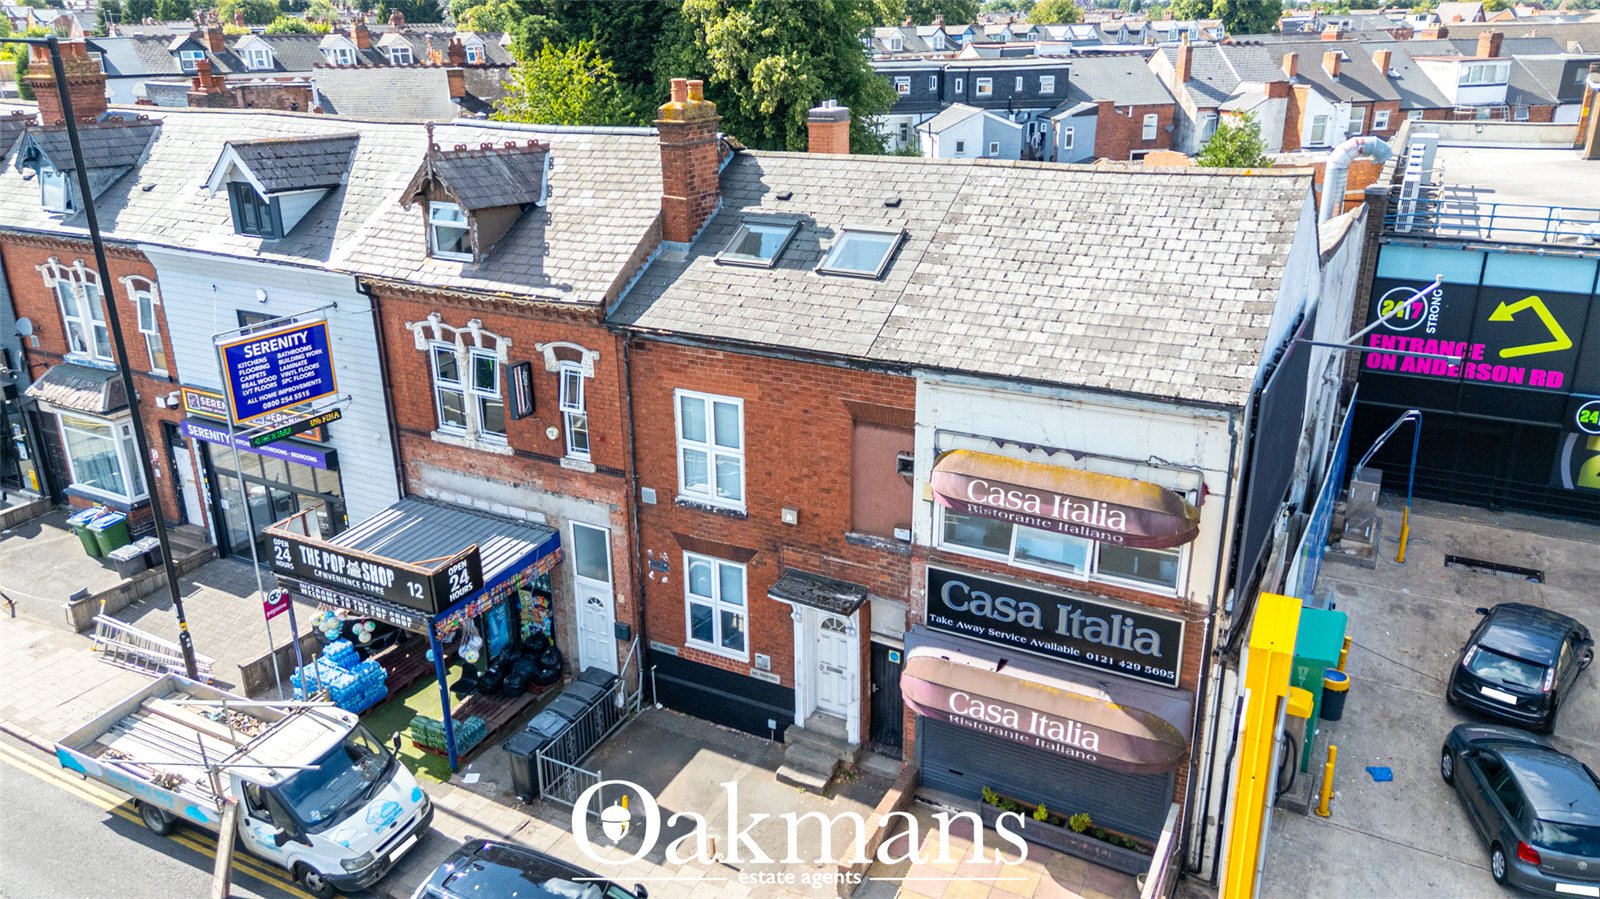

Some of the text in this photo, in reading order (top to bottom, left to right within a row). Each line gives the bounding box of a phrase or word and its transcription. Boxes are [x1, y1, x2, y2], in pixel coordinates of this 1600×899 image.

[1426, 289, 1443, 334] STRONG
[244, 331, 308, 358] SERENITY
[277, 344, 312, 358] BATHROOMS
[1369, 334, 1485, 360] ENTRANCE
[238, 356, 268, 369] KITCHENS
[278, 349, 323, 365] BUILDING WORK
[280, 359, 308, 372] LAMINATE
[239, 362, 270, 376] FLOORING
[240, 370, 266, 382] CARPETS
[280, 362, 320, 378] VINYL FLOORS
[282, 370, 315, 385] SPC FLOORS
[1366, 352, 1564, 389] ON ANDERSON RD
[242, 374, 277, 389] REAL WOOD
[242, 381, 277, 396] LVT FLOORS
[259, 391, 277, 401] HOME
[278, 378, 322, 396] IMPROVEMENTS
[200, 396, 226, 410] SEREN
[262, 390, 310, 409] 0800 254 5515
[1580, 409, 1600, 424] 24
[188, 424, 230, 444] SERENITY
[290, 452, 318, 463] BEDROOMS
[967, 479, 1127, 531] Casa Italia
[967, 503, 1124, 544] Ristorante Italiano
[273, 538, 289, 548] OPEN
[274, 546, 292, 562] 24
[276, 560, 294, 570] HOURS
[299, 545, 394, 588] THE POP SHOP
[448, 560, 467, 576] OPEN
[314, 568, 385, 596] CONVENIENCE STORE
[449, 570, 470, 592] 24
[406, 581, 424, 599] 12
[450, 583, 473, 602] HOURS
[266, 602, 287, 618] payzone
[300, 582, 412, 628] WELCOME TO THE POP SHOP
[940, 580, 1162, 658] Casa Italia
[929, 614, 1175, 679] Take Away Service Available 0121 429 5695
[760, 672, 778, 682] PARKING
[949, 691, 1099, 751] Casa Italia
[949, 714, 1097, 762] Ristorante Italiano
